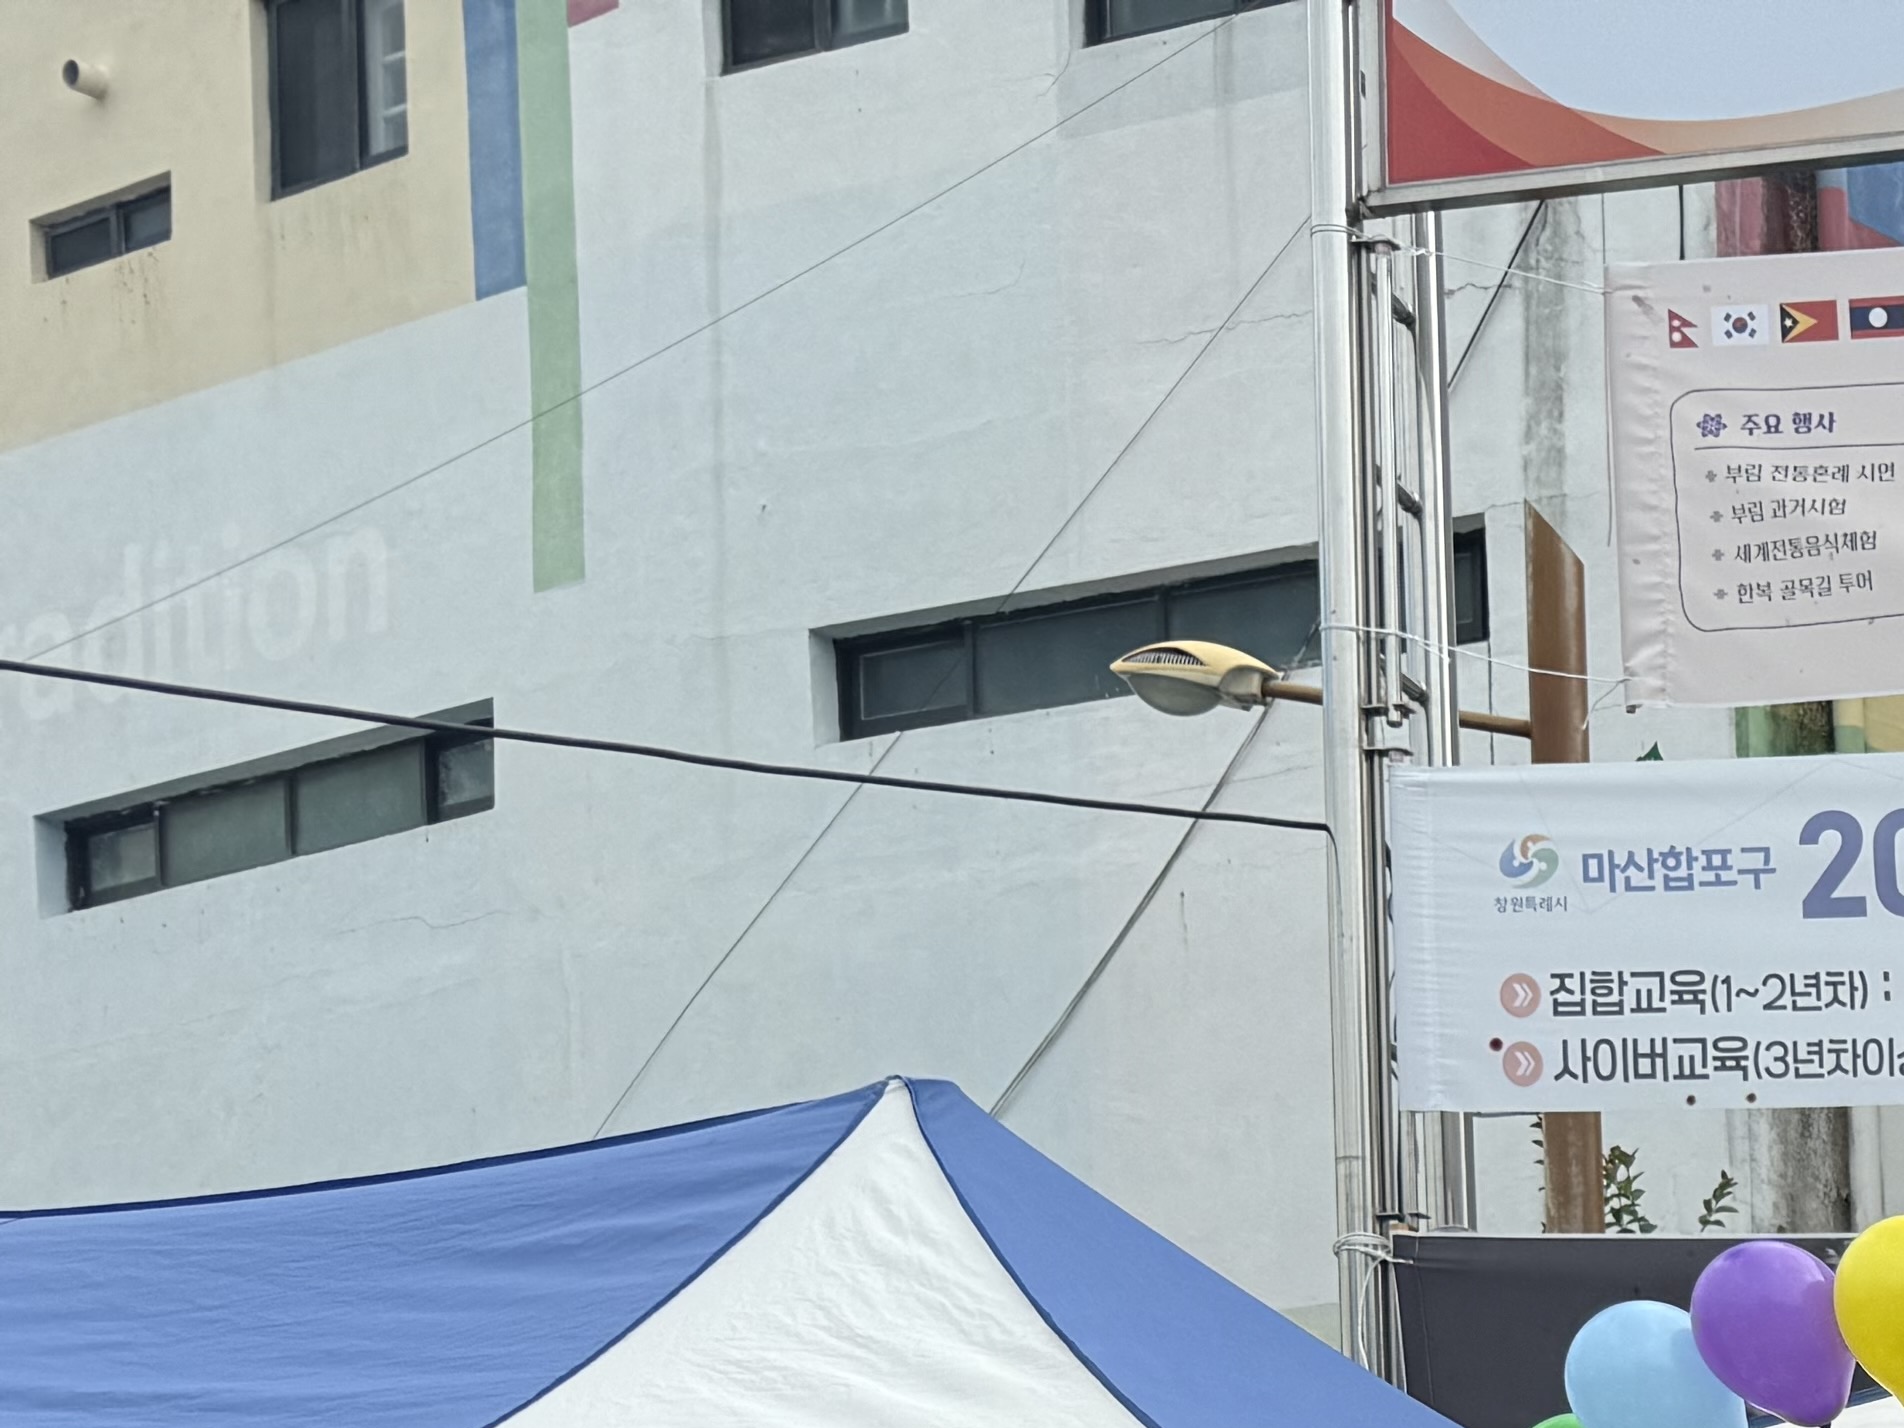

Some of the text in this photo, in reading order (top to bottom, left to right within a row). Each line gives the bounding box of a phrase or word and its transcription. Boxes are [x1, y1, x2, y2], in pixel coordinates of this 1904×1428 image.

[1740, 411, 1837, 436] 주요 행사
[1725, 464, 1763, 484] 부림
[1731, 501, 1764, 524] 부림
[1737, 570, 1874, 604] 한복 골목길 투어
[1582, 844, 1776, 894] 마산합포구
[1494, 895, 1568, 914] 창원특례시
